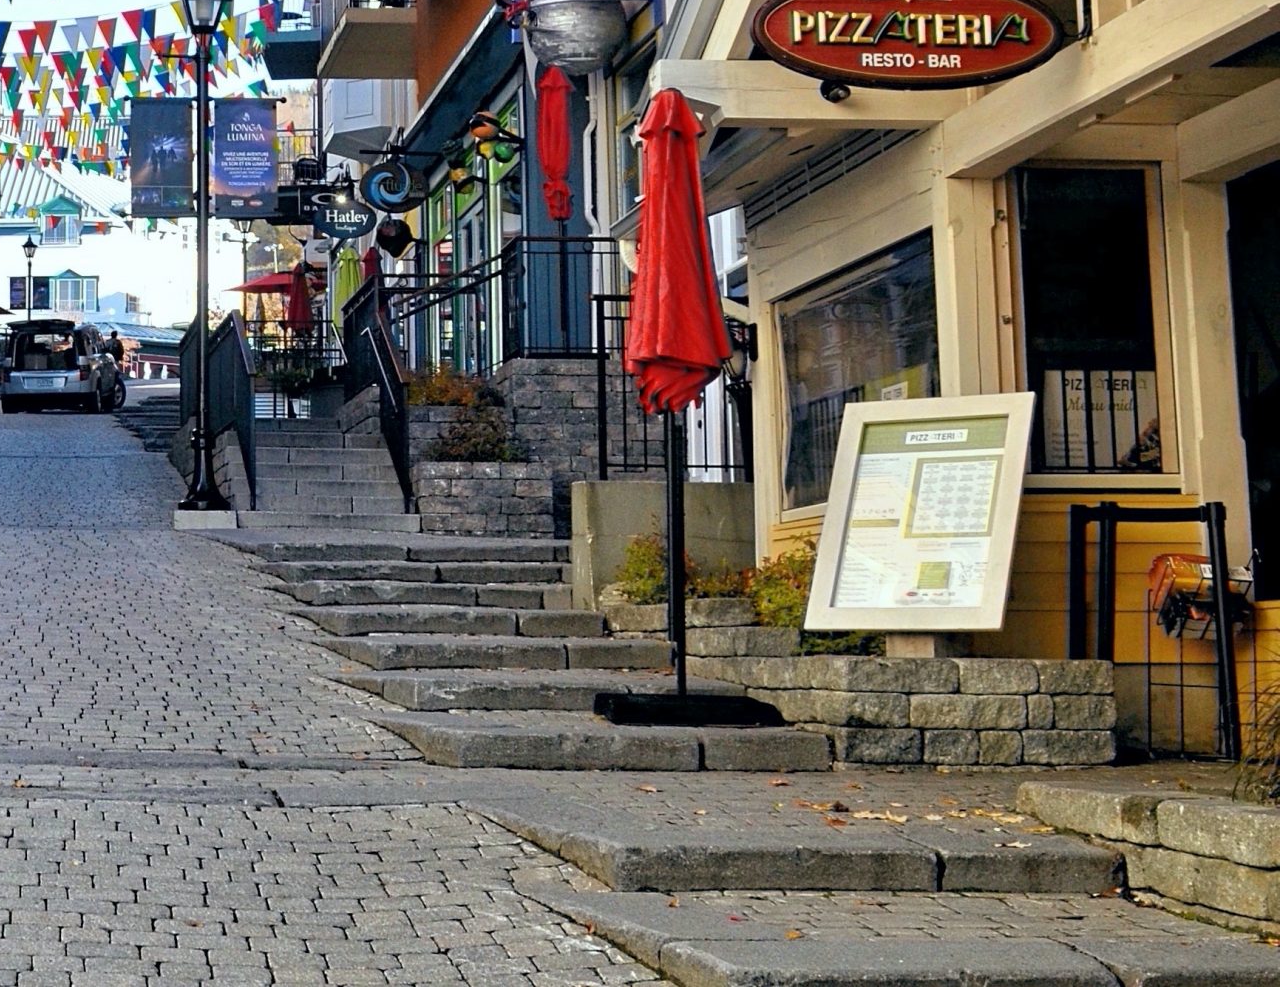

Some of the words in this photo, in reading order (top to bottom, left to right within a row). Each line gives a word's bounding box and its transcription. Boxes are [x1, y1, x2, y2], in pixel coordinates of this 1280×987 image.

[791, 10, 1030, 46] PIZZATERIA
[862, 53, 914, 68] RESTO
[928, 53, 961, 69] BAR
[230, 123, 263, 132] TONGA
[226, 132, 266, 142] LUMINA
[325, 209, 369, 226] Hatley
